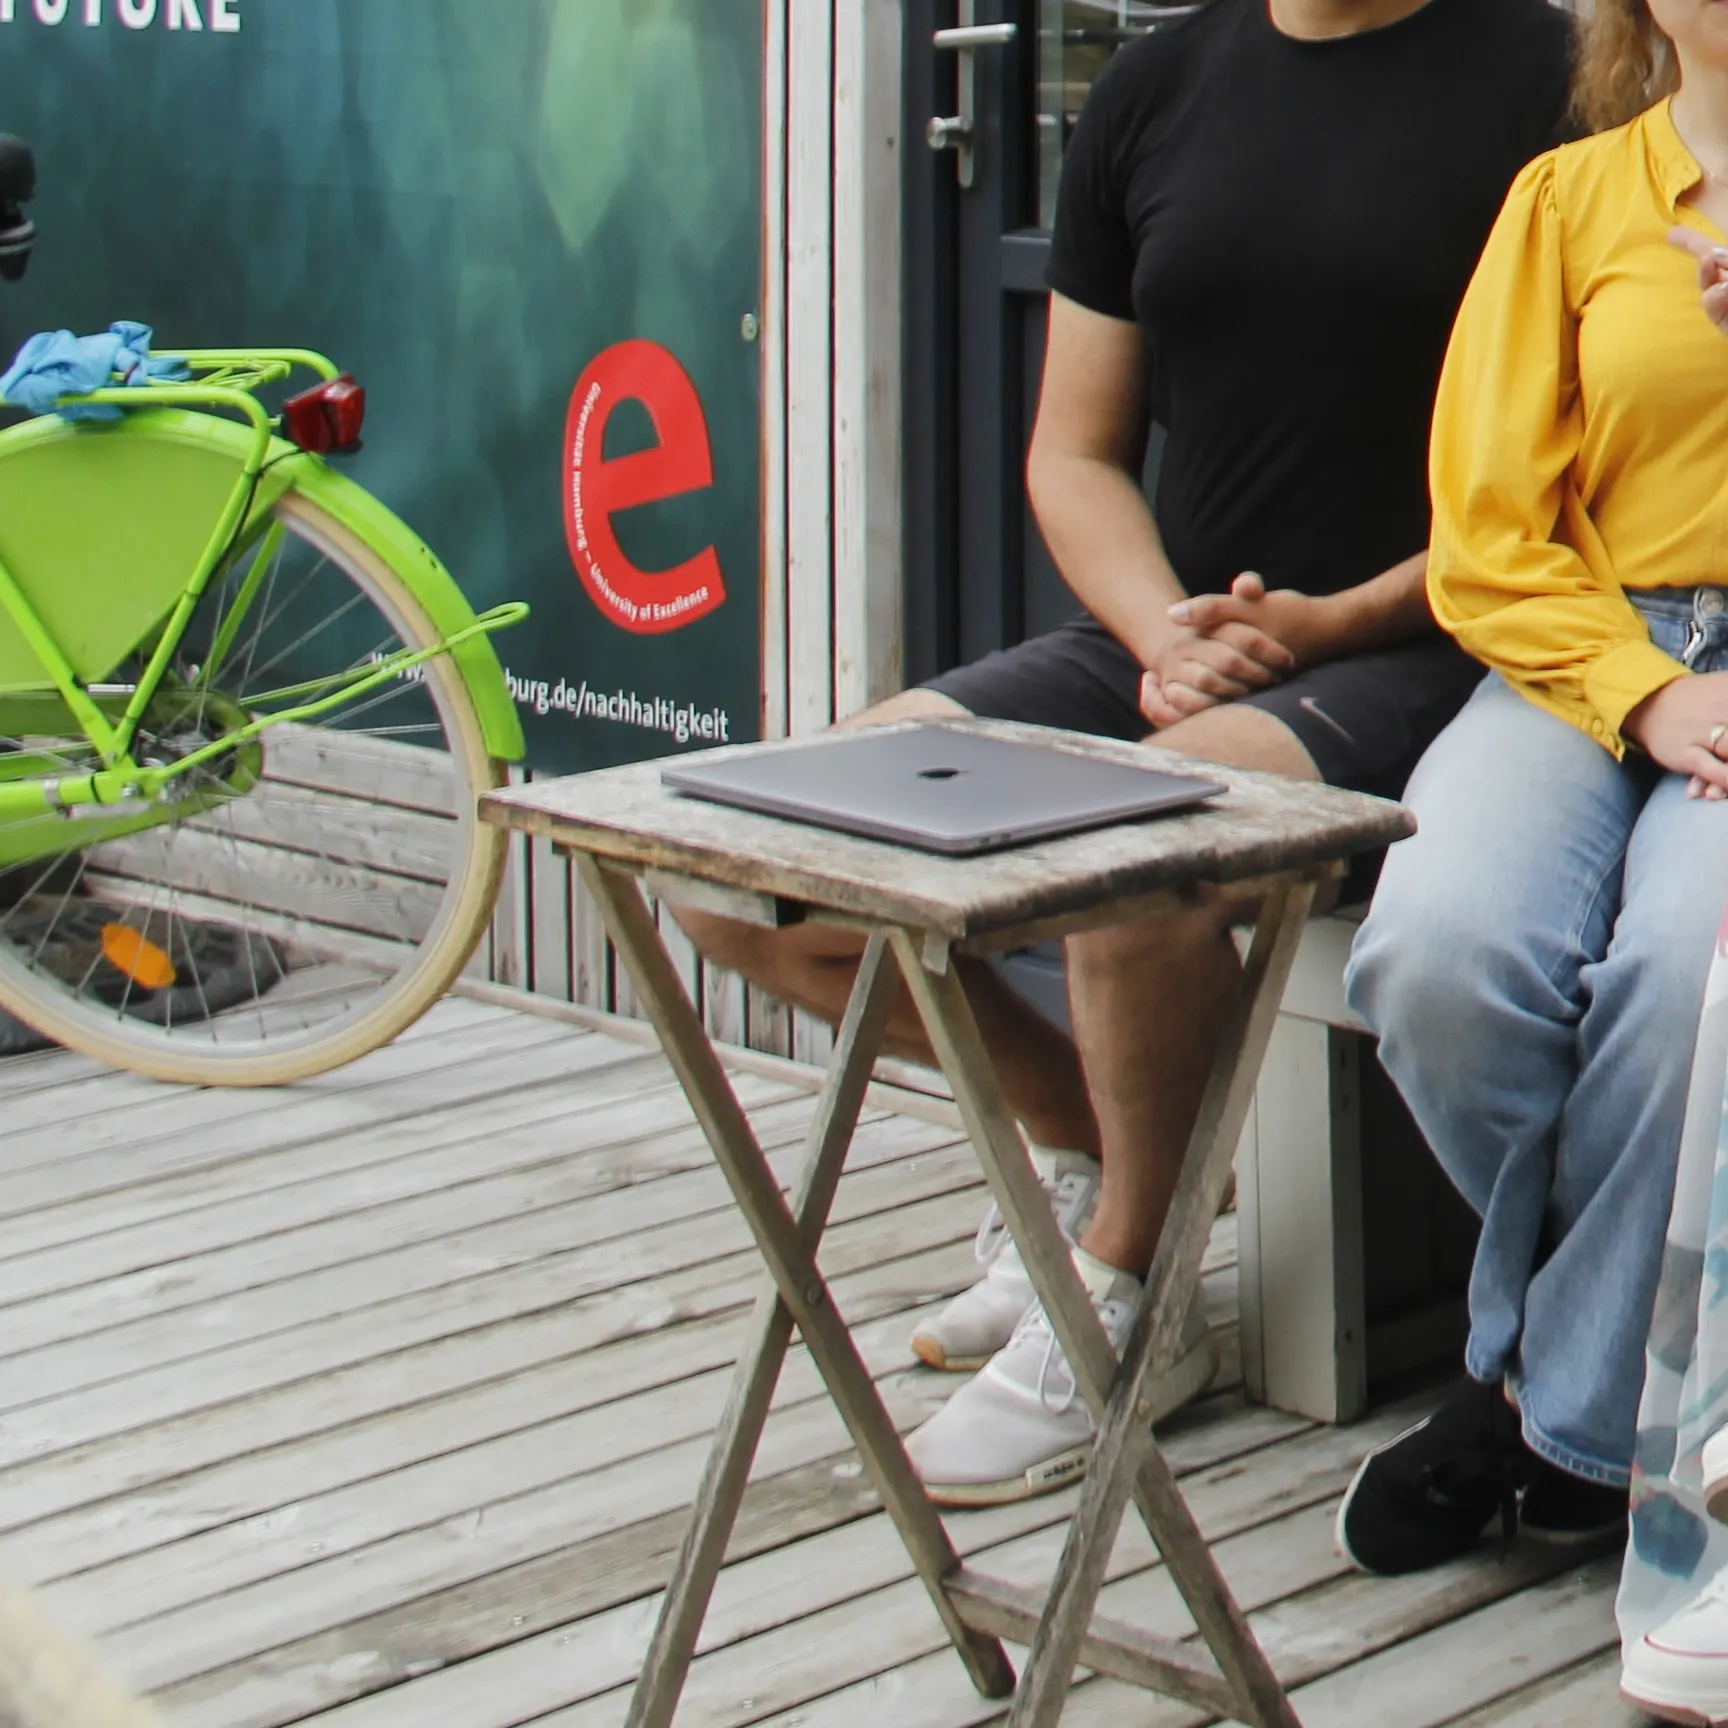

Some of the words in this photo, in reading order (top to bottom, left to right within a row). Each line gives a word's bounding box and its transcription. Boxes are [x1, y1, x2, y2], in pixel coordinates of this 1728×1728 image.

[590, 562, 639, 622] University
[639, 602, 652, 621] of
[653, 585, 710, 621] Excellence
